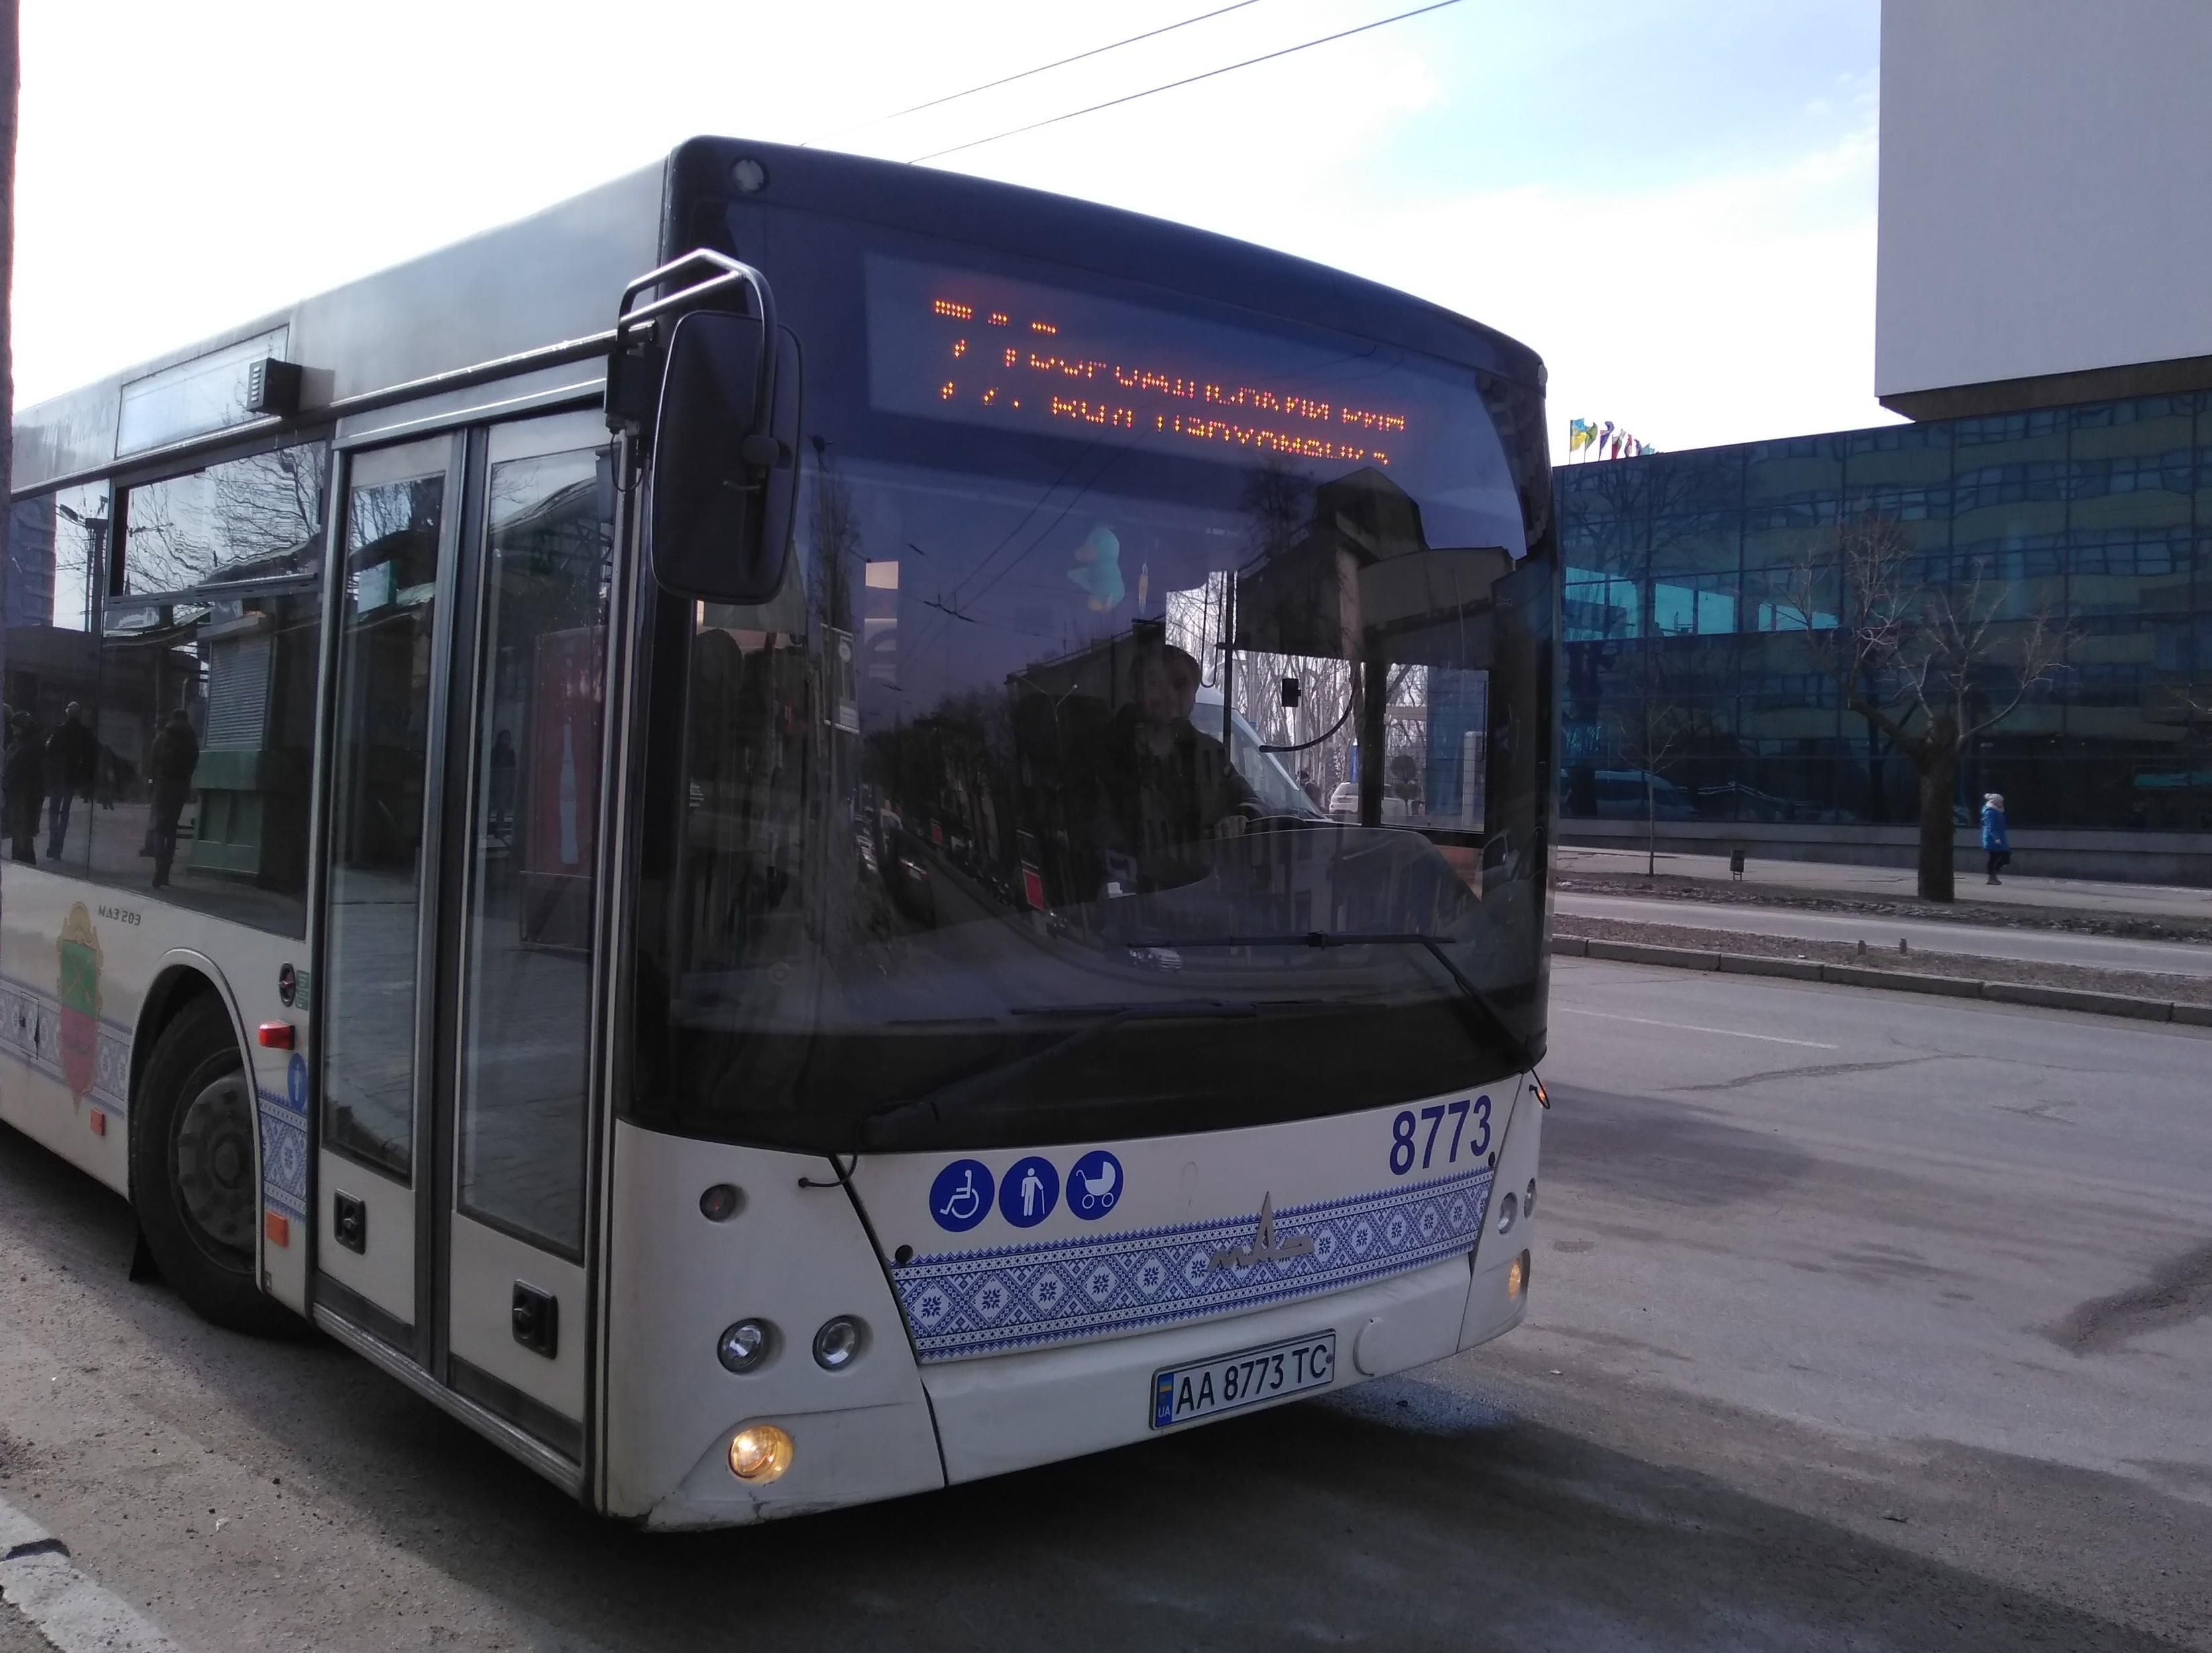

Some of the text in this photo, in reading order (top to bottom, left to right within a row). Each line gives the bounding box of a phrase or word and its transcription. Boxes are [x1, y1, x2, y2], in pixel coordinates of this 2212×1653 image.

[121, 910, 141, 926] 203
[1389, 1094, 1492, 1176] 8773
[1176, 1344, 1328, 1414] AA 8773 TC
